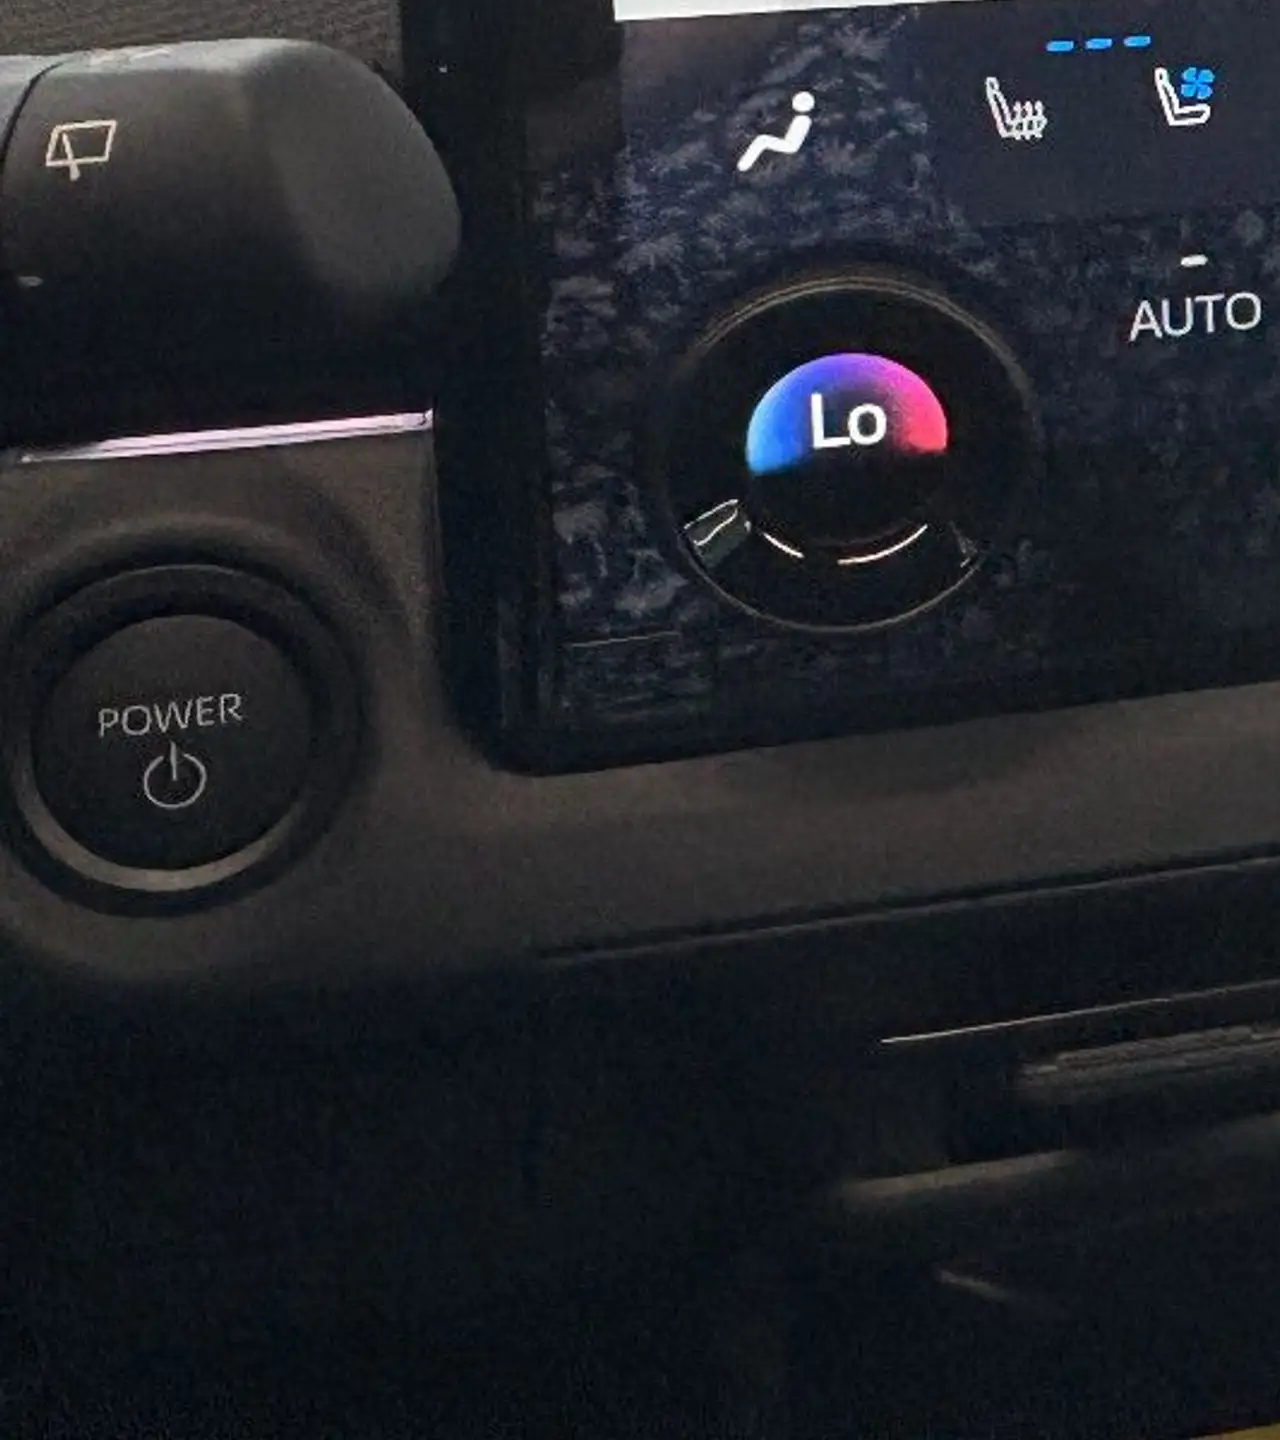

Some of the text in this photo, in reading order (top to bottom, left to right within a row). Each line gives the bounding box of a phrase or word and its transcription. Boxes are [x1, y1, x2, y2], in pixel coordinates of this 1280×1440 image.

[1129, 292, 1263, 342] AUTO
[810, 392, 888, 449] Lo
[97, 691, 244, 739] POWER
